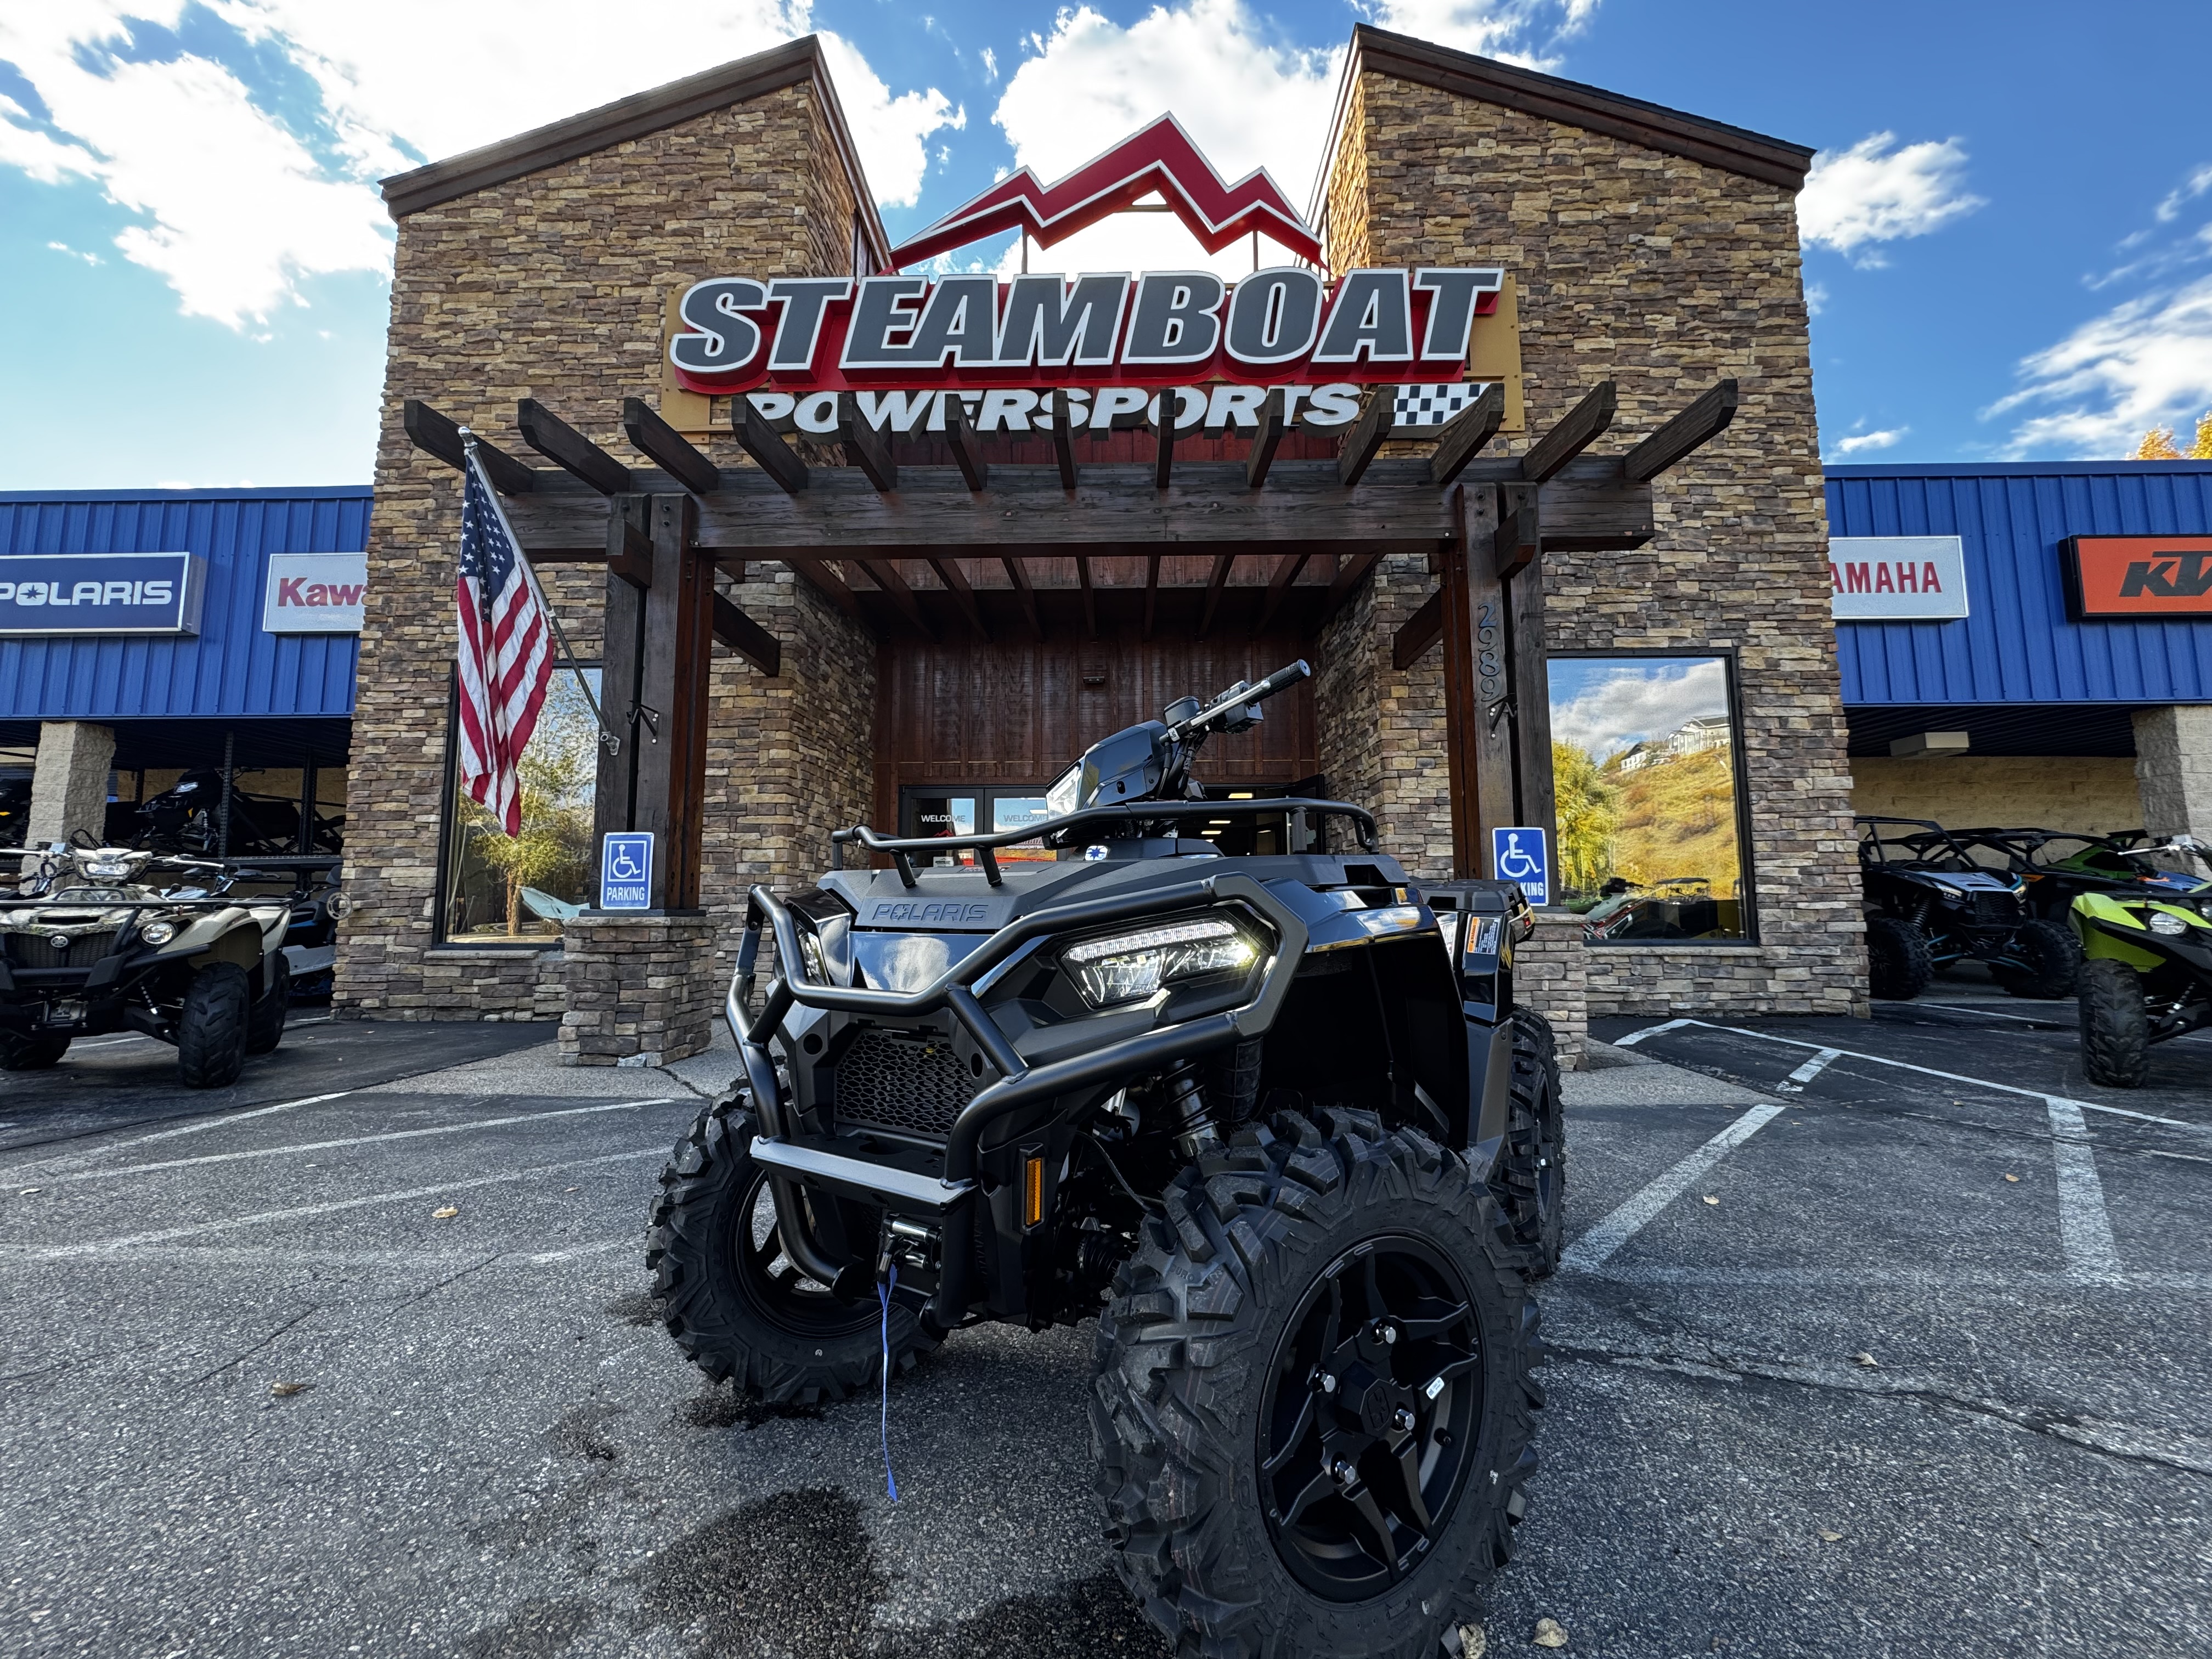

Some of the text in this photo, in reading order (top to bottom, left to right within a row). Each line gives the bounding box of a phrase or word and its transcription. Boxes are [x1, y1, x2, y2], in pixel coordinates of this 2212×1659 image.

[669, 267, 1505, 374] STEAMBOAT
[278, 577, 368, 607] Kaw
[1478, 602, 1501, 702] 2989
[606, 887, 645, 901] PARKING
[872, 904, 989, 922] POLARIS
[1169, 1263, 1194, 1283] DURO
